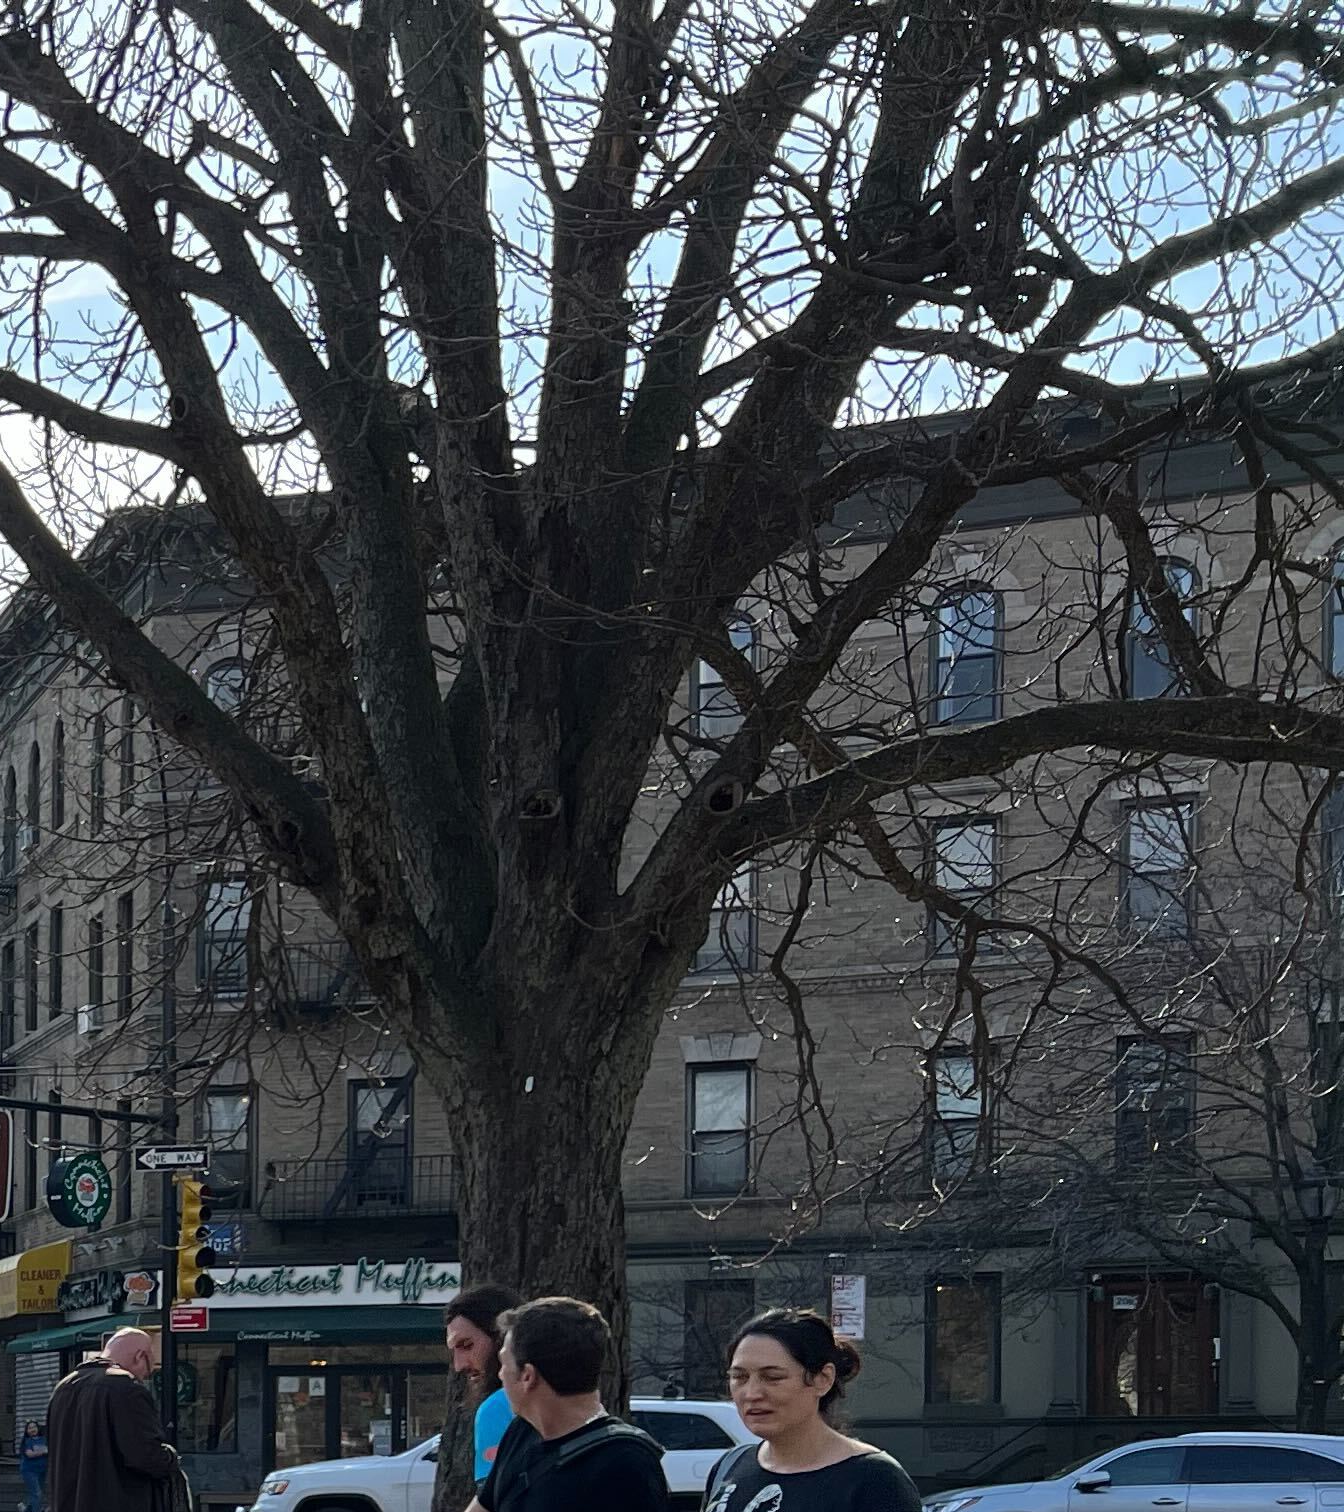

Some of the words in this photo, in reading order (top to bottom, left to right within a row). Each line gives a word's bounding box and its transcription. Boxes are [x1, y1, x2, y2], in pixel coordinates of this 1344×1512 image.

[146, 1154, 167, 1164] ONE
[176, 1152, 200, 1162] WAY
[20, 1269, 62, 1282] CLEANER
[211, 1264, 343, 1296] nnecticut
[356, 1256, 461, 1302] Muffin
[37, 1285, 45, 1295] &
